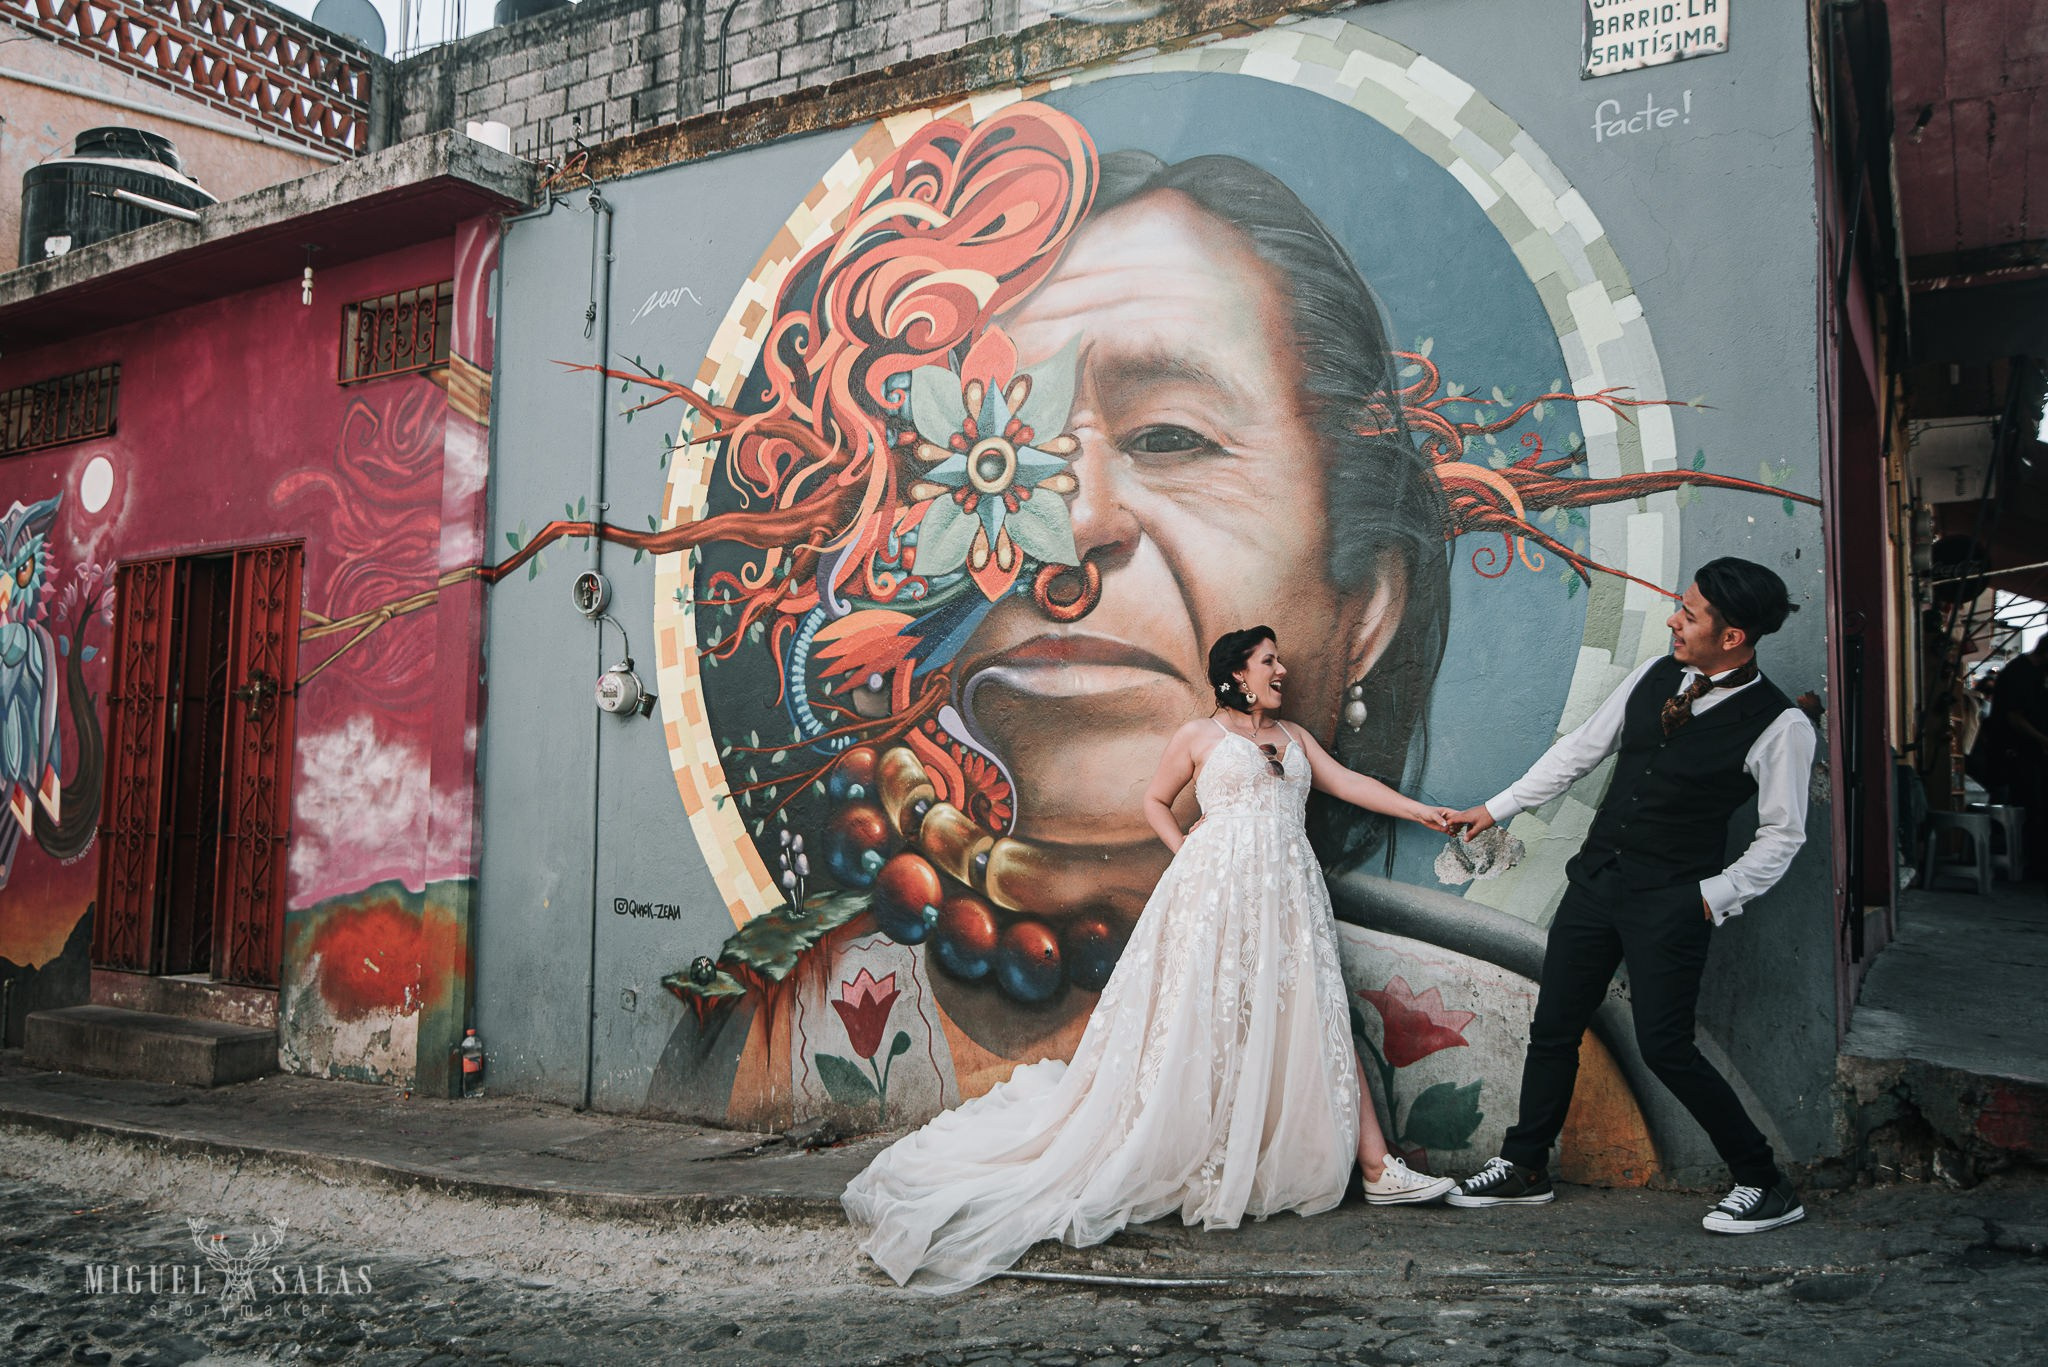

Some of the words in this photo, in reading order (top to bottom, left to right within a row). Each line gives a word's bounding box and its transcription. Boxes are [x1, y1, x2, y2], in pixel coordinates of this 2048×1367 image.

[1593, 3, 1681, 37] BARRIO:
[1687, 0, 1717, 18] LA
[1593, 25, 1716, 66] SANTÍSIMA
[1590, 89, 1692, 143] facte!
